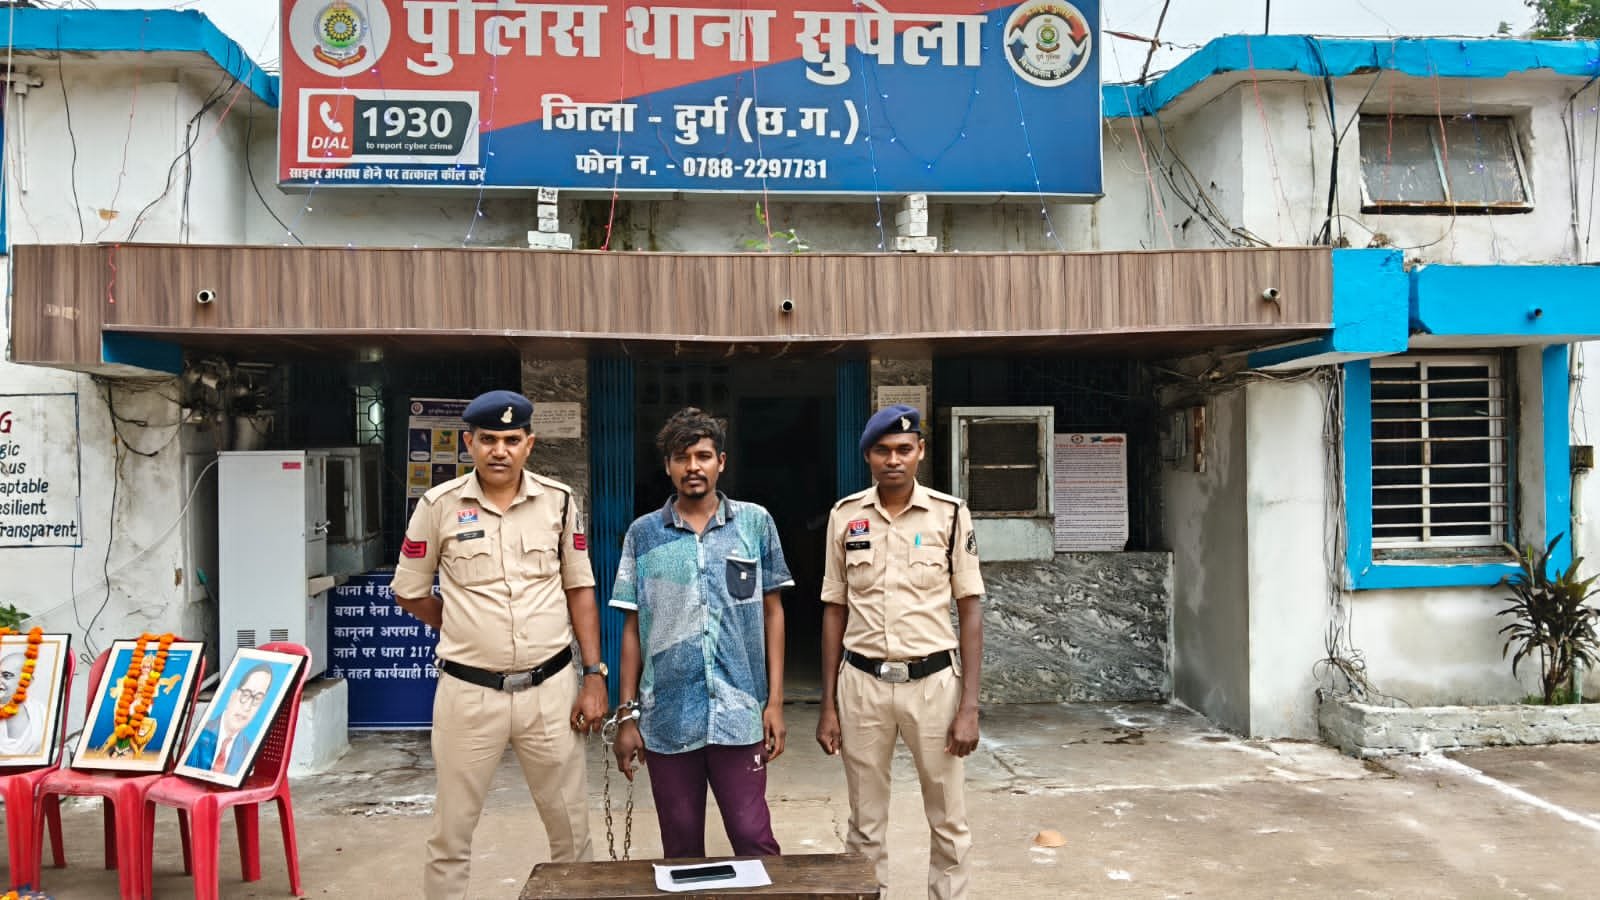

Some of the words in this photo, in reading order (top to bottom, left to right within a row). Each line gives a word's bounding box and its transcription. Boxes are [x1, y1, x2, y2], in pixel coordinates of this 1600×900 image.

[403, 0, 608, 76] पुलिस
[625, 6, 777, 62] थाना
[793, 0, 988, 85] सुपेला
[362, 106, 453, 138] 1930
[541, 94, 638, 132] जिला
[673, 96, 728, 144] दुर्ग
[737, 97, 859, 144] (छ.ग.)
[311, 136, 349, 150] DIAL
[376, 143, 402, 151] report
[404, 142, 428, 151] cyber
[576, 149, 624, 174] फोन
[629, 155, 657, 175] न.
[682, 157, 827, 178] 0788-2297731
[289, 168, 322, 180] साइबर
[324, 168, 361, 179] अपराध
[363, 166, 382, 179] होने
[385, 168, 399, 179] पर
[401, 168, 438, 180] तत्काल
[0, 520, 77, 542] ransparent
[335, 585, 362, 596] थाना
[365, 581, 375, 596] में
[334, 606, 366, 616] बयान
[369, 601, 390, 616] देना
[334, 626, 374, 642] कानूनन
[380, 626, 419, 637] अपराध
[333, 643, 358, 658] जाने
[362, 647, 377, 658] पर
[381, 647, 405, 658] धारा
[410, 646, 435, 660] 217,
[333, 664, 344, 679] के
[348, 668, 372, 679] तहत
[374, 663, 422, 679] कार्यवाही
